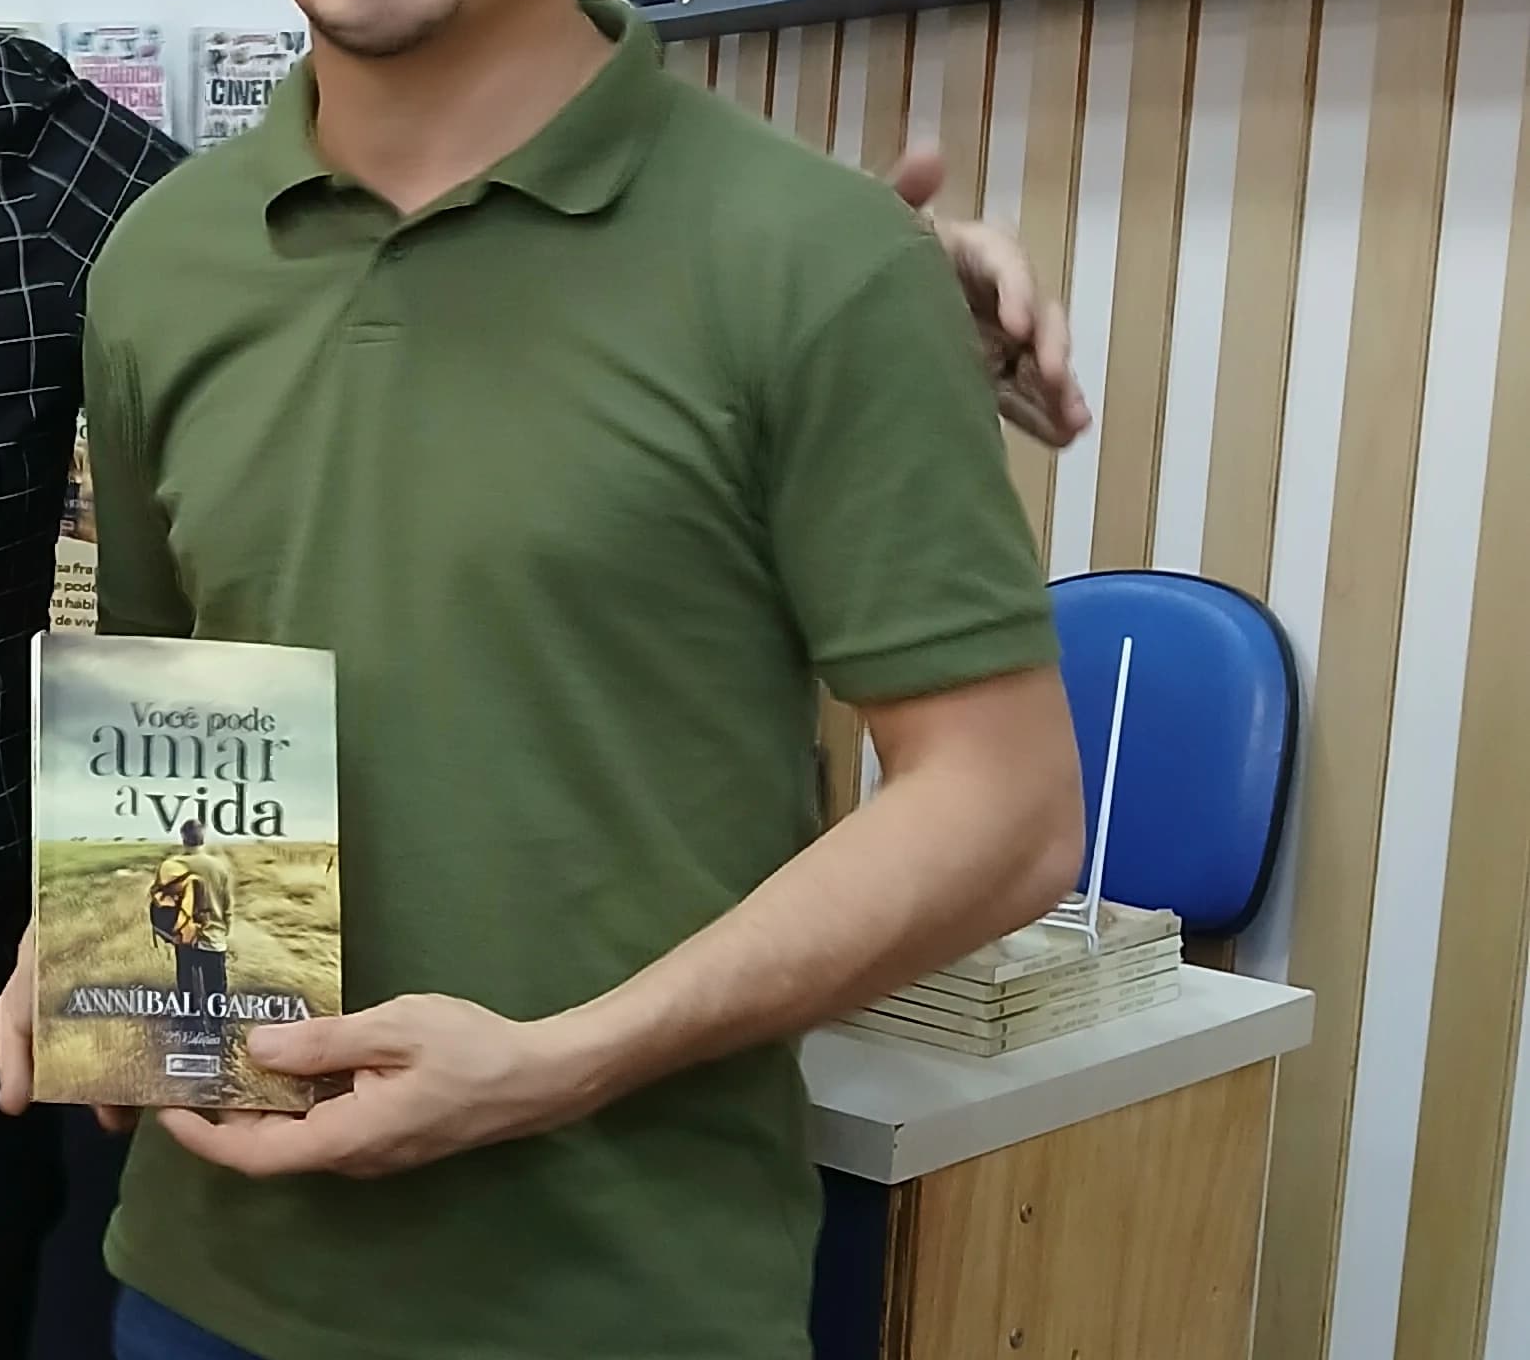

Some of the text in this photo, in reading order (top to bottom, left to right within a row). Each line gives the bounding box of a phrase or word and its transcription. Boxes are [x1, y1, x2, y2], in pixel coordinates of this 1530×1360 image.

[130, 701, 277, 738] Você pode
[89, 724, 291, 783] amar
[115, 781, 288, 838] a vida
[206, 992, 313, 1021] GARCIA
